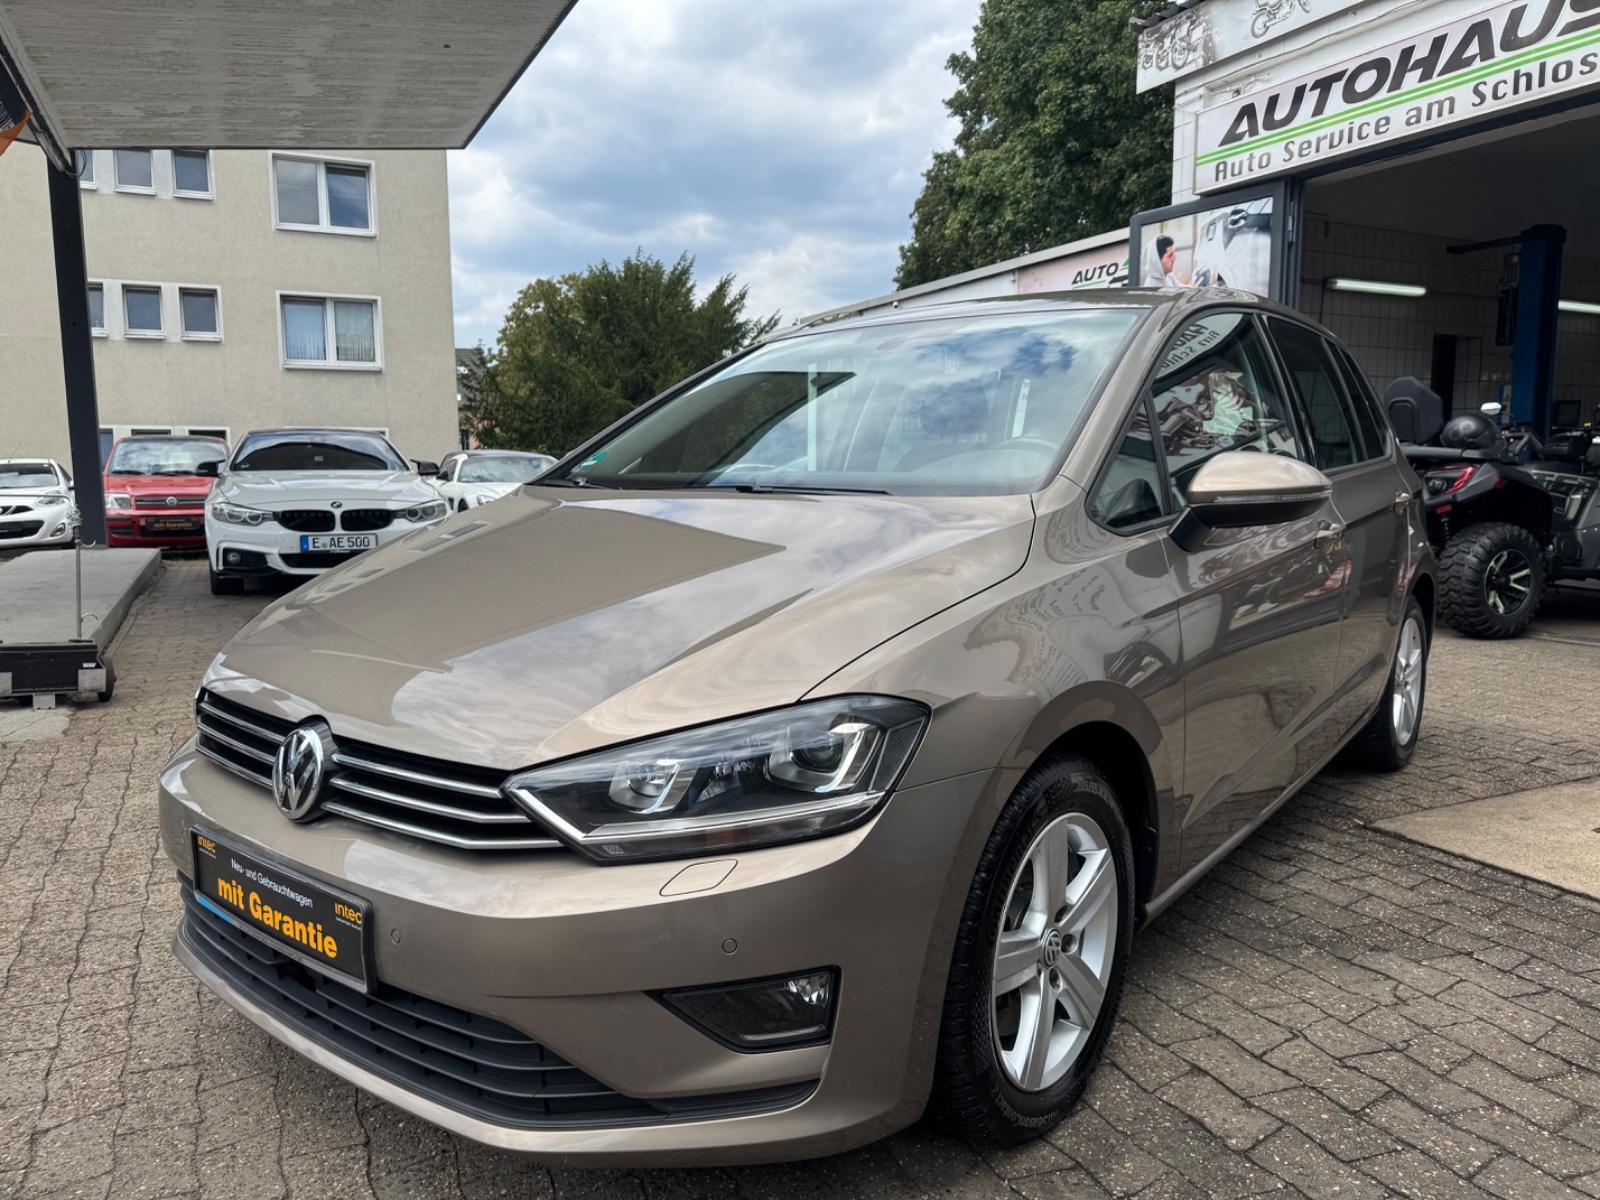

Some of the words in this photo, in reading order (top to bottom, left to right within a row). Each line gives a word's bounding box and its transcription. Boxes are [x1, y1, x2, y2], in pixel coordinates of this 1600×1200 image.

[1214, 152, 1272, 182] Auto
[1282, 113, 1391, 162] Service
[1404, 96, 1455, 127] am
[1471, 52, 1598, 107] Schlos
[1071, 262, 1119, 285] AUTO
[312, 537, 321, 549] E
[329, 537, 345, 548] AE
[347, 536, 370, 548] 500
[231, 858, 245, 873] Neu-
[245, 867, 257, 881] und
[257, 873, 313, 908] Gebrauchtwagen
[217, 878, 245, 910] mit
[249, 891, 338, 958] Garantie
